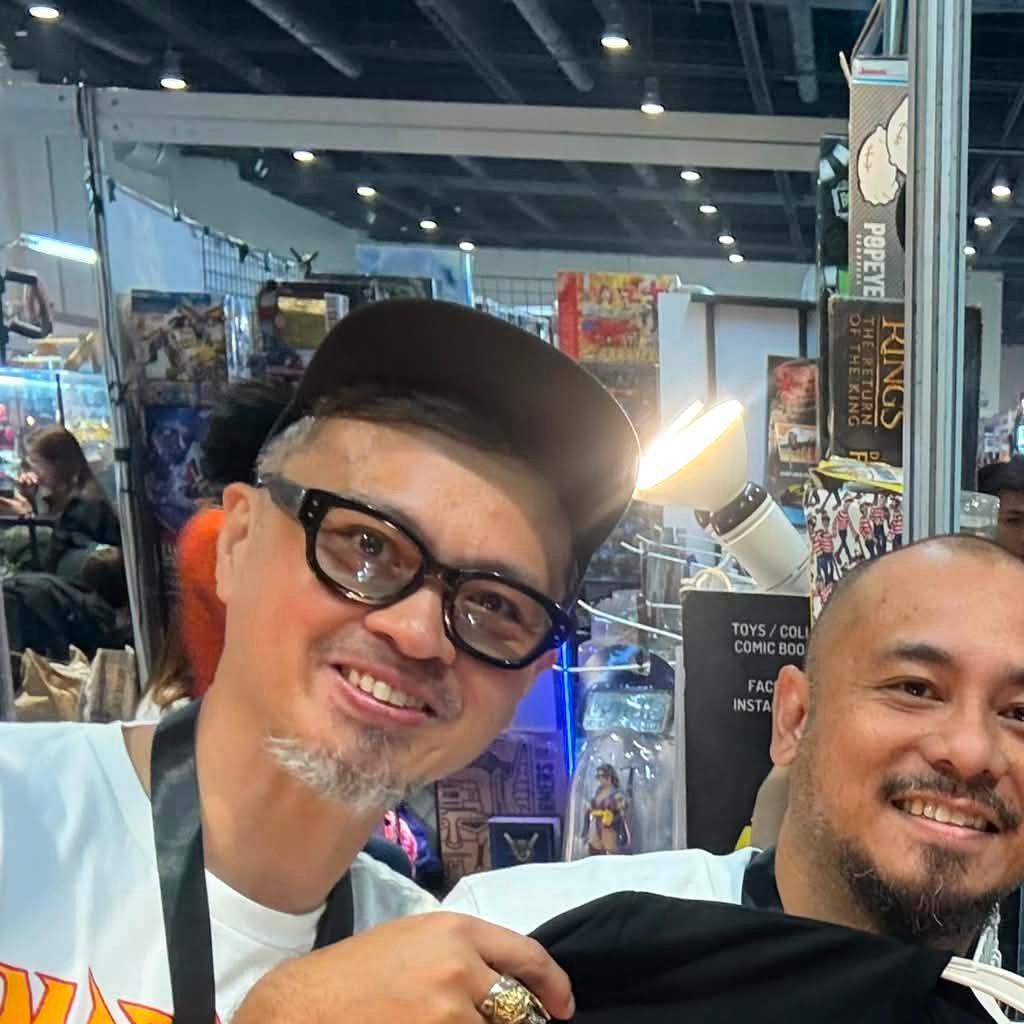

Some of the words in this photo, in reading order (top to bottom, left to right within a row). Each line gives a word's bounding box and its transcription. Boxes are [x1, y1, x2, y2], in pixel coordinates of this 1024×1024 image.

[862, 222, 886, 297] POPEYE
[848, 312, 861, 335] OF
[862, 317, 875, 346] THE
[848, 344, 861, 374] THE
[880, 315, 905, 429] RINGS
[847, 383, 860, 427] KING
[860, 357, 874, 425] RETURN
[731, 622, 766, 638] TOYS
[734, 640, 776, 655] COMIC
